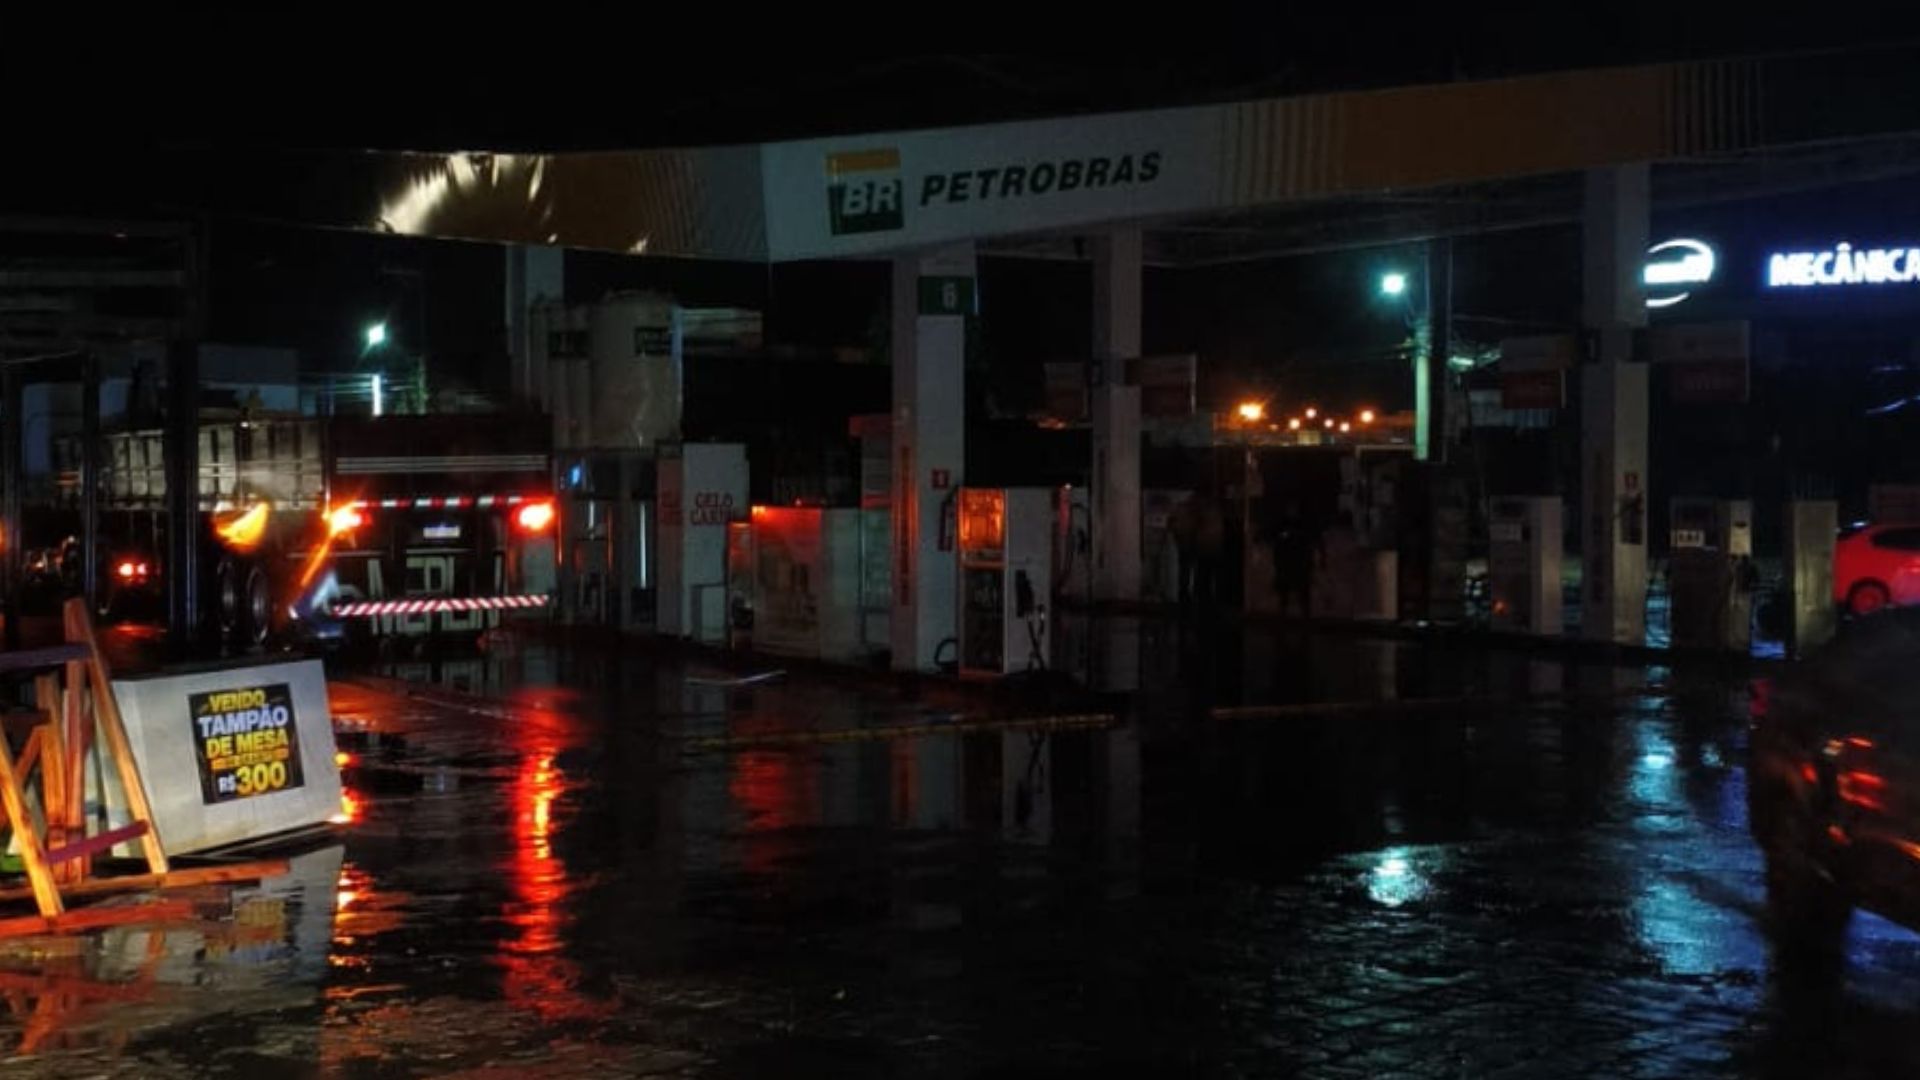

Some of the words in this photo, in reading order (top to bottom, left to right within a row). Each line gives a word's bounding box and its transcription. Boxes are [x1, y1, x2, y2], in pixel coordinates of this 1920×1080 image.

[841, 181, 901, 217] BR
[921, 151, 1162, 206] PETROBRAS
[1769, 242, 1920, 286] MECÂNICA
[209, 689, 265, 712] VENDO
[198, 704, 289, 737] TAMPÃO
[206, 735, 233, 760] DE
[236, 728, 289, 754] MESA
[236, 761, 286, 797] 300
